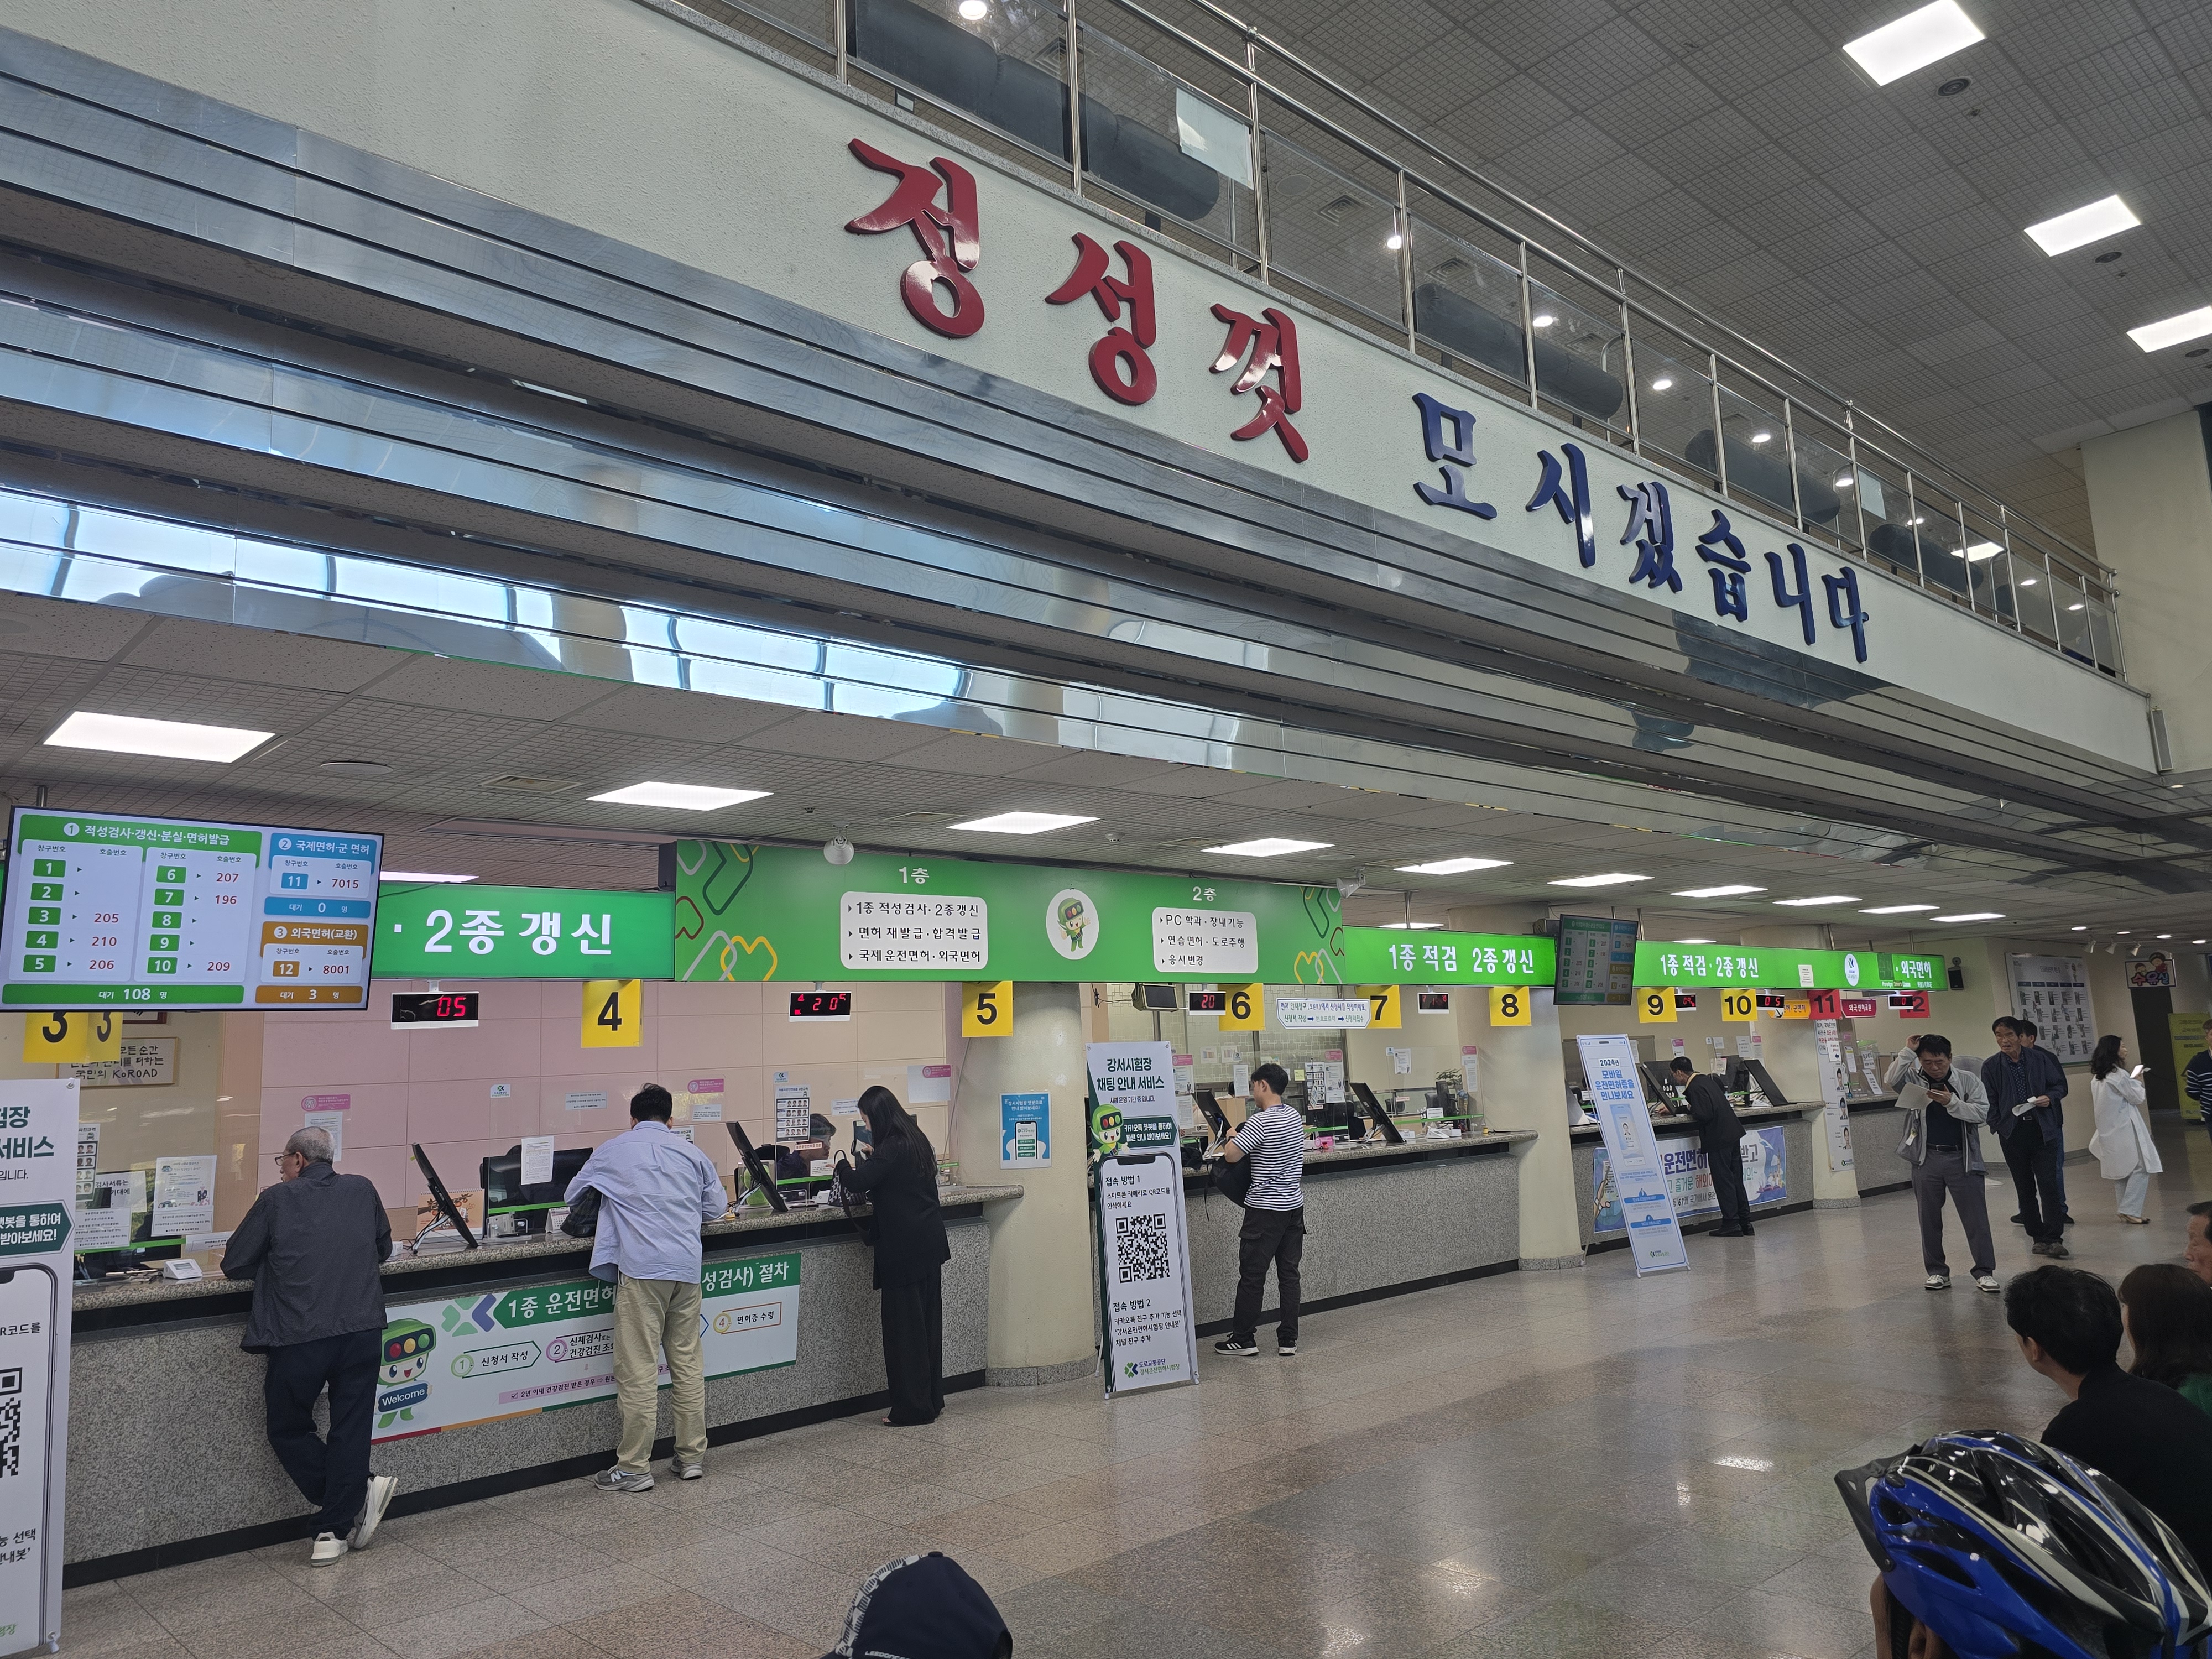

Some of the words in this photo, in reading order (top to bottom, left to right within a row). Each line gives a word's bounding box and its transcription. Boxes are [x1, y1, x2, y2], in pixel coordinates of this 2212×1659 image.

[844, 138, 1309, 463] 정성껏
[1412, 392, 1870, 662] 모시겠습니다
[351, 844, 369, 855] 면허
[46, 862, 52, 874] 1
[167, 869, 176, 880] 6
[216, 873, 239, 883] 207
[288, 875, 300, 887] 11
[332, 879, 359, 889] 7015
[899, 867, 930, 884] 1층
[42, 886, 51, 898] 2
[165, 892, 173, 903] 7
[216, 895, 237, 905] 196
[1193, 886, 1217, 901] 2층
[318, 902, 326, 912] 0
[857, 902, 874, 914] 1종
[39, 910, 49, 922] 3
[94, 913, 119, 923] 205
[162, 915, 171, 926] 8
[1166, 915, 1182, 926] PC
[291, 928, 357, 940] 외국면허(교환)
[425, 909, 504, 954] 2종
[519, 912, 611, 956] 갱신
[859, 927, 881, 940] 면허
[36, 934, 47, 946] 4
[92, 936, 117, 946] 210
[160, 937, 169, 948] 9
[859, 950, 881, 961] 국제
[1169, 954, 1203, 966] 응시변경
[1389, 945, 1416, 971] 1종
[1423, 946, 1457, 972] 적검
[1473, 948, 1498, 973] 2종
[1502, 949, 1534, 974] 갱신
[35, 958, 44, 970] 5
[89, 960, 114, 969] 206
[155, 960, 171, 971] 10
[207, 962, 230, 971] 209
[280, 964, 294, 974] 12
[323, 965, 349, 974] 8001
[1661, 954, 1679, 977] 1종
[1682, 955, 1706, 977] 적검
[1716, 957, 1734, 978] 2종
[1736, 957, 1759, 978] 갱신
[1901, 961, 1932, 979] 외국면허
[2131, 971, 2169, 986] 수유실
[124, 988, 150, 1000] 108
[160, 991, 167, 999] 명
[309, 989, 317, 1000] 3
[977, 993, 997, 1025] 5
[1232, 992, 1251, 1019] 6
[1281, 1003, 1289, 1011] 먼저
[1370, 995, 1387, 1020] 7
[1501, 994, 1519, 1018] 8
[1647, 994, 1664, 1015] 9
[1724, 995, 1752, 1015] 10
[1814, 995, 1834, 1013] 11
[598, 992, 622, 1031] 4
[1298, 1015, 1306, 1023] 작성
[42, 1011, 67, 1043] 3
[139, 1046, 158, 1055] 순간
[136, 1057, 164, 1067] 더하는
[1107, 1057, 1152, 1072] 강서시험장
[76, 1070, 106, 1080] 국민의
[113, 1068, 158, 1079] KoROAD
[1601, 1070, 1623, 1079] 모바일
[1097, 1077, 1115, 1091] 채팅
[1117, 1077, 1136, 1091] 안내
[1138, 1076, 1165, 1089] 서비스
[1595, 1079, 1635, 1090] 운전면허증을
[1600, 1090, 1635, 1101] 만나보세요
[1124, 1124, 1142, 1132] 카카오톡
[1144, 1123, 1157, 1131] 챗봇을
[1158, 1122, 1172, 1130] 통하여
[0, 1136, 54, 1160] 서비스
[96, 1180, 129, 1188] 검사서류는
[1105, 1177, 1119, 1187] 접속
[1121, 1175, 1134, 1185] 방법
[1675, 1176, 1693, 1192] 즐거운
[1149, 1187, 1170, 1196] QR코드를
[1107, 1201, 1131, 1210] 인식하세요
[29, 1212, 61, 1227] 통하여
[0, 1229, 57, 1245] 받아보세요!
[508, 1296, 538, 1318] 1종
[545, 1285, 615, 1315] 운전면허
[759, 1261, 789, 1283] 절차
[1113, 1302, 1127, 1312] 접속
[1130, 1299, 1144, 1310] 방법
[719, 1318, 724, 1327] 4
[737, 1314, 758, 1324] 면허증
[760, 1311, 774, 1321] 수령
[1115, 1316, 1135, 1326] 카카오톡
[1172, 1310, 1182, 1318] 선택
[1116, 1338, 1126, 1347] 채널
[1128, 1337, 1139, 1345] 친구
[1140, 1335, 1151, 1343] 추가
[554, 1345, 560, 1355] 2
[569, 1345, 601, 1358] 건강검진
[481, 1353, 508, 1368] 신청서
[511, 1350, 528, 1364] 작성
[1139, 1358, 1166, 1368] 도로교통공단
[546, 1384, 570, 1394] 건강검진
[382, 1389, 425, 1406] Welcome
[13, 1528, 36, 1544] 선택
